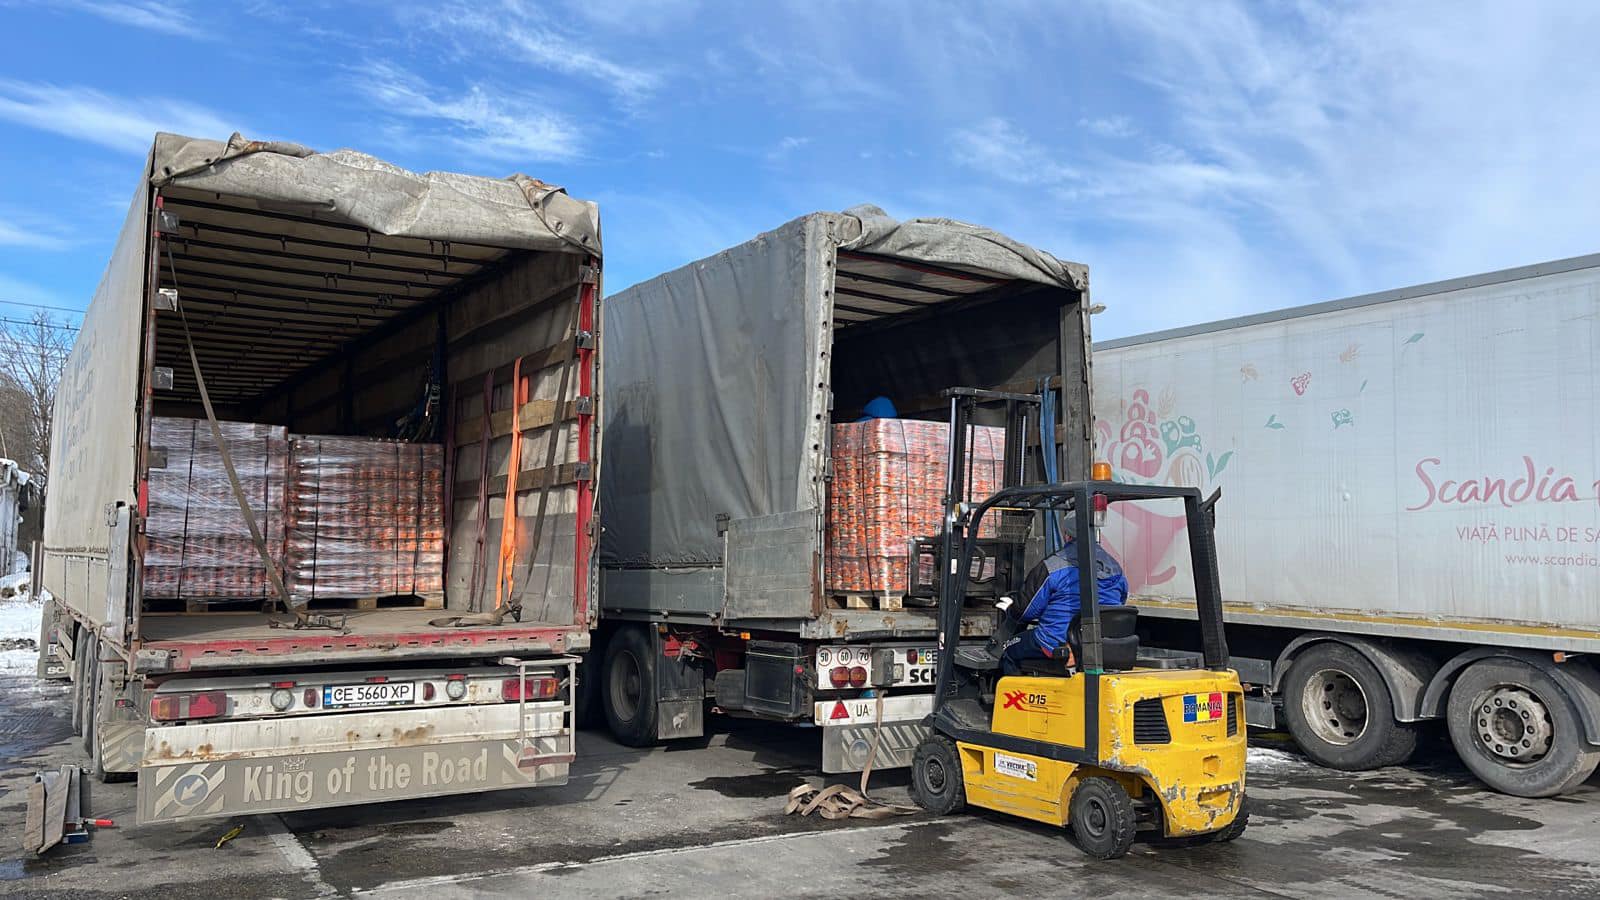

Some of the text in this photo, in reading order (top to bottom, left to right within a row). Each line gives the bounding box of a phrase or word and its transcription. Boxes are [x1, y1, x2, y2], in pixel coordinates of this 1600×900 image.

[1406, 456, 1580, 511] Scandia
[1504, 522, 1551, 543] PLINĂ
[1556, 527, 1578, 543] DE
[820, 652, 829, 663] 50
[840, 651, 849, 662] 60
[859, 651, 869, 661] 70
[333, 688, 353, 701] CE
[357, 686, 388, 701] 5660
[391, 685, 410, 698] XP
[1028, 694, 1047, 705] D15
[856, 703, 870, 717] UA
[1184, 702, 1222, 714] ROMANIA
[243, 748, 488, 803] King of the Road
